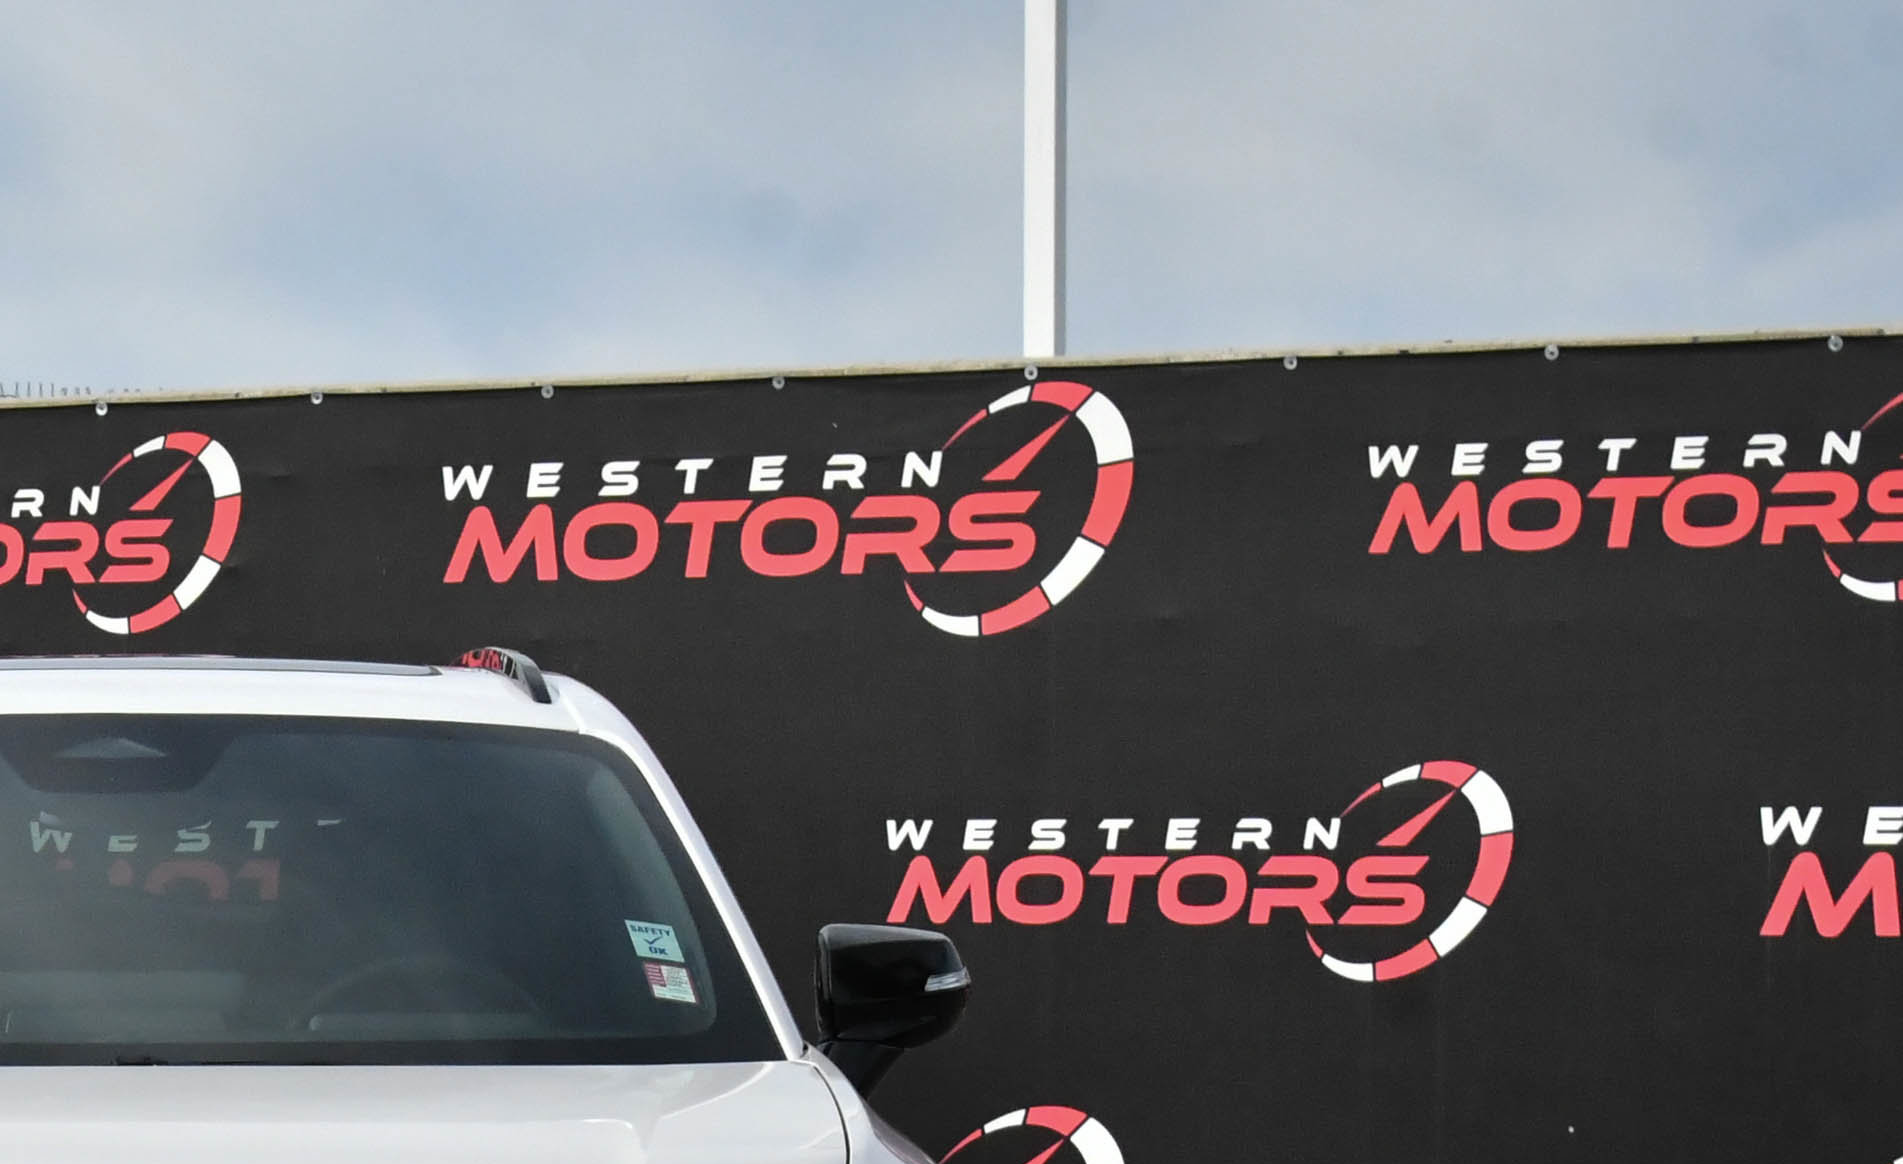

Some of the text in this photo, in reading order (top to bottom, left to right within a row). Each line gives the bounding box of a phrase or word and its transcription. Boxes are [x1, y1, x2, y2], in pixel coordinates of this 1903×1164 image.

[442, 451, 944, 500] WESTERN
[1368, 430, 1862, 478] WESTERN
[443, 490, 1041, 584] MOTORS
[886, 817, 1342, 851] WESTERN
[1760, 806, 1903, 846] WE
[886, 854, 1430, 926] MOTORS
[1760, 850, 1903, 939] M
[629, 924, 671, 937] SAFETY
[648, 946, 668, 956] OK
